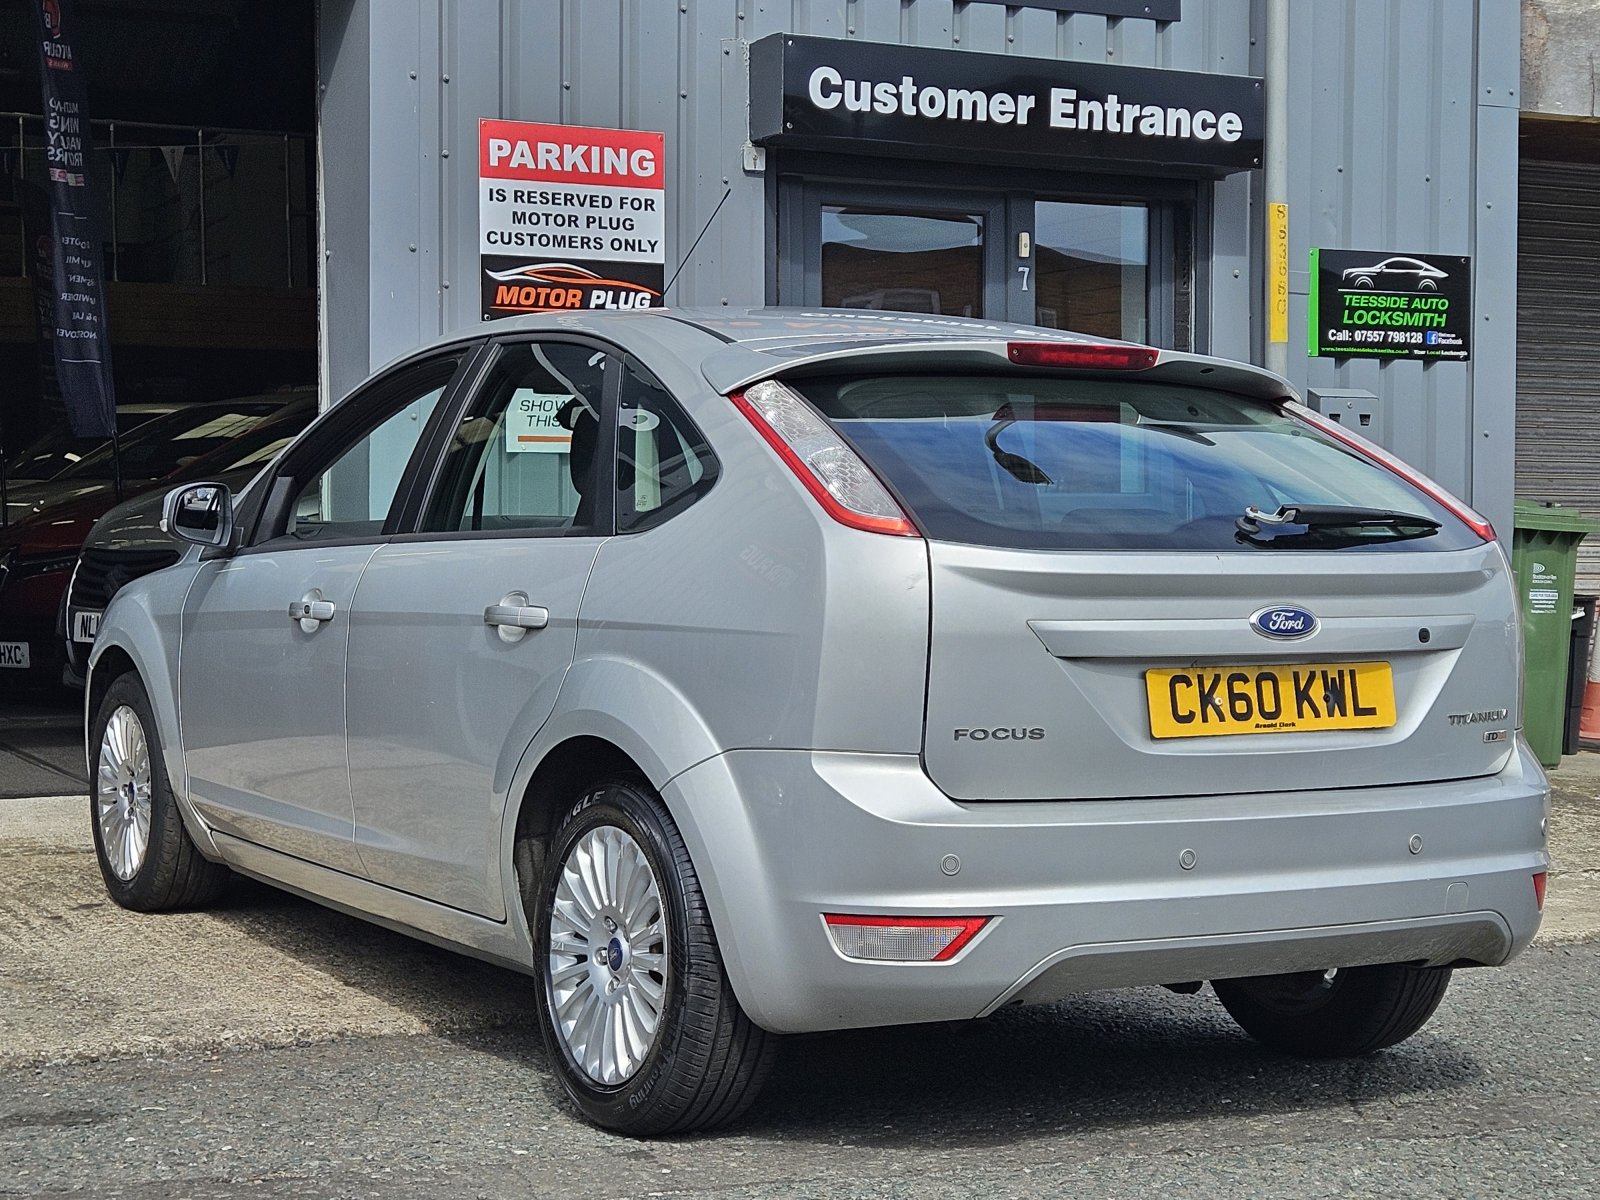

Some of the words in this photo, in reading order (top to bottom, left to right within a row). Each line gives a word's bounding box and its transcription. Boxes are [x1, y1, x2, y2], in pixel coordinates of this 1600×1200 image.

[808, 65, 1036, 125] Customer
[1049, 88, 1244, 142] Entrance
[489, 138, 656, 177] PARKING
[488, 188, 507, 202] IS
[513, 189, 613, 209] RESERVED
[619, 196, 656, 212] FOR
[512, 211, 580, 228] MOTOR
[586, 216, 635, 231] PLUG
[486, 231, 604, 250] CUSTOMERS
[610, 238, 658, 253] ONLY
[1018, 267, 1030, 291] 7
[496, 285, 582, 308] MOTOR
[589, 289, 652, 310] PLUG
[1344, 294, 1409, 309] TEESSIDE
[1411, 298, 1449, 310] AUTO
[1343, 310, 1447, 327] LOCKSMITH
[1328, 329, 1352, 341] Call:
[1354, 330, 1386, 342] 07557
[1387, 331, 1423, 343] 798128
[527, 415, 560, 427] THIS
[80, 614, 100, 638] NL
[1269, 611, 1304, 630] Ford
[1169, 671, 1282, 724] CK60
[1293, 669, 1377, 719] KWL
[953, 727, 1045, 741] FOCUS
